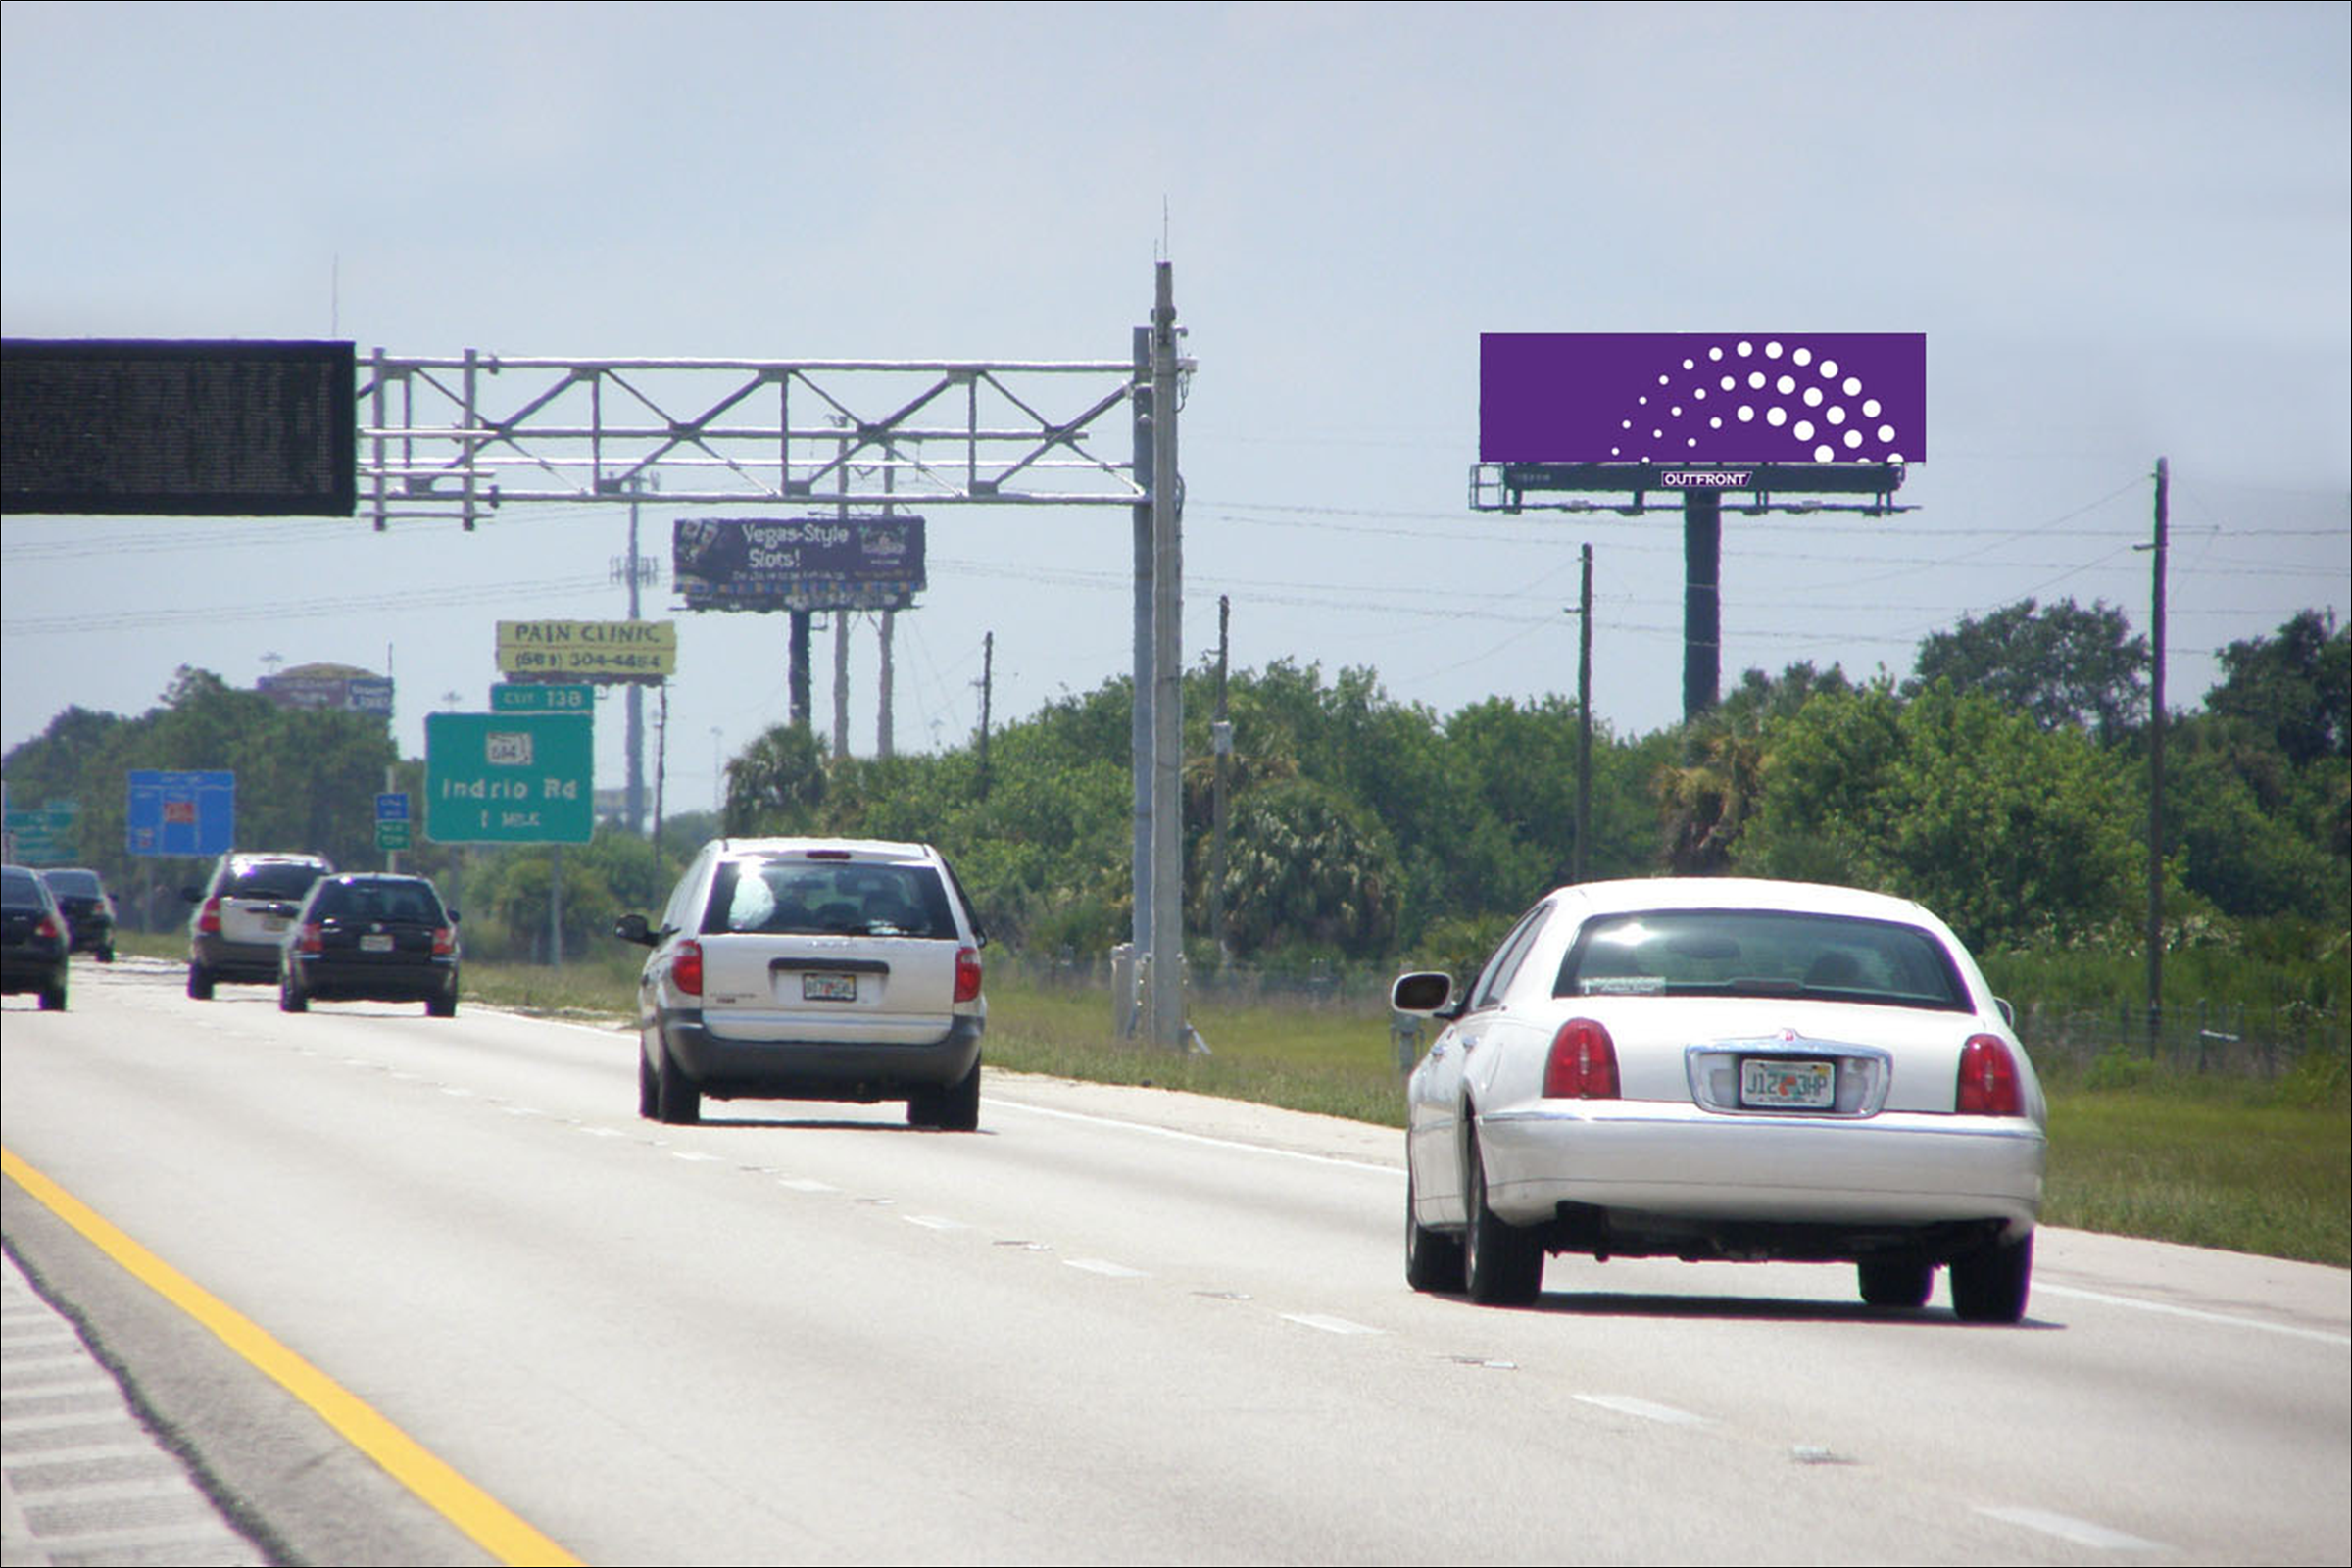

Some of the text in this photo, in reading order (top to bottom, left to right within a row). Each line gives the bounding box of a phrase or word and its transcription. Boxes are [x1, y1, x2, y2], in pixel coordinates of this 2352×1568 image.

[1664, 473, 1748, 486] OUTFRONT
[741, 523, 850, 550] Vegas-Style
[749, 548, 801, 568] Slots!
[514, 623, 661, 644] PAIN CLINIC
[546, 690, 583, 708] 138
[442, 777, 578, 800] Indrio Rd
